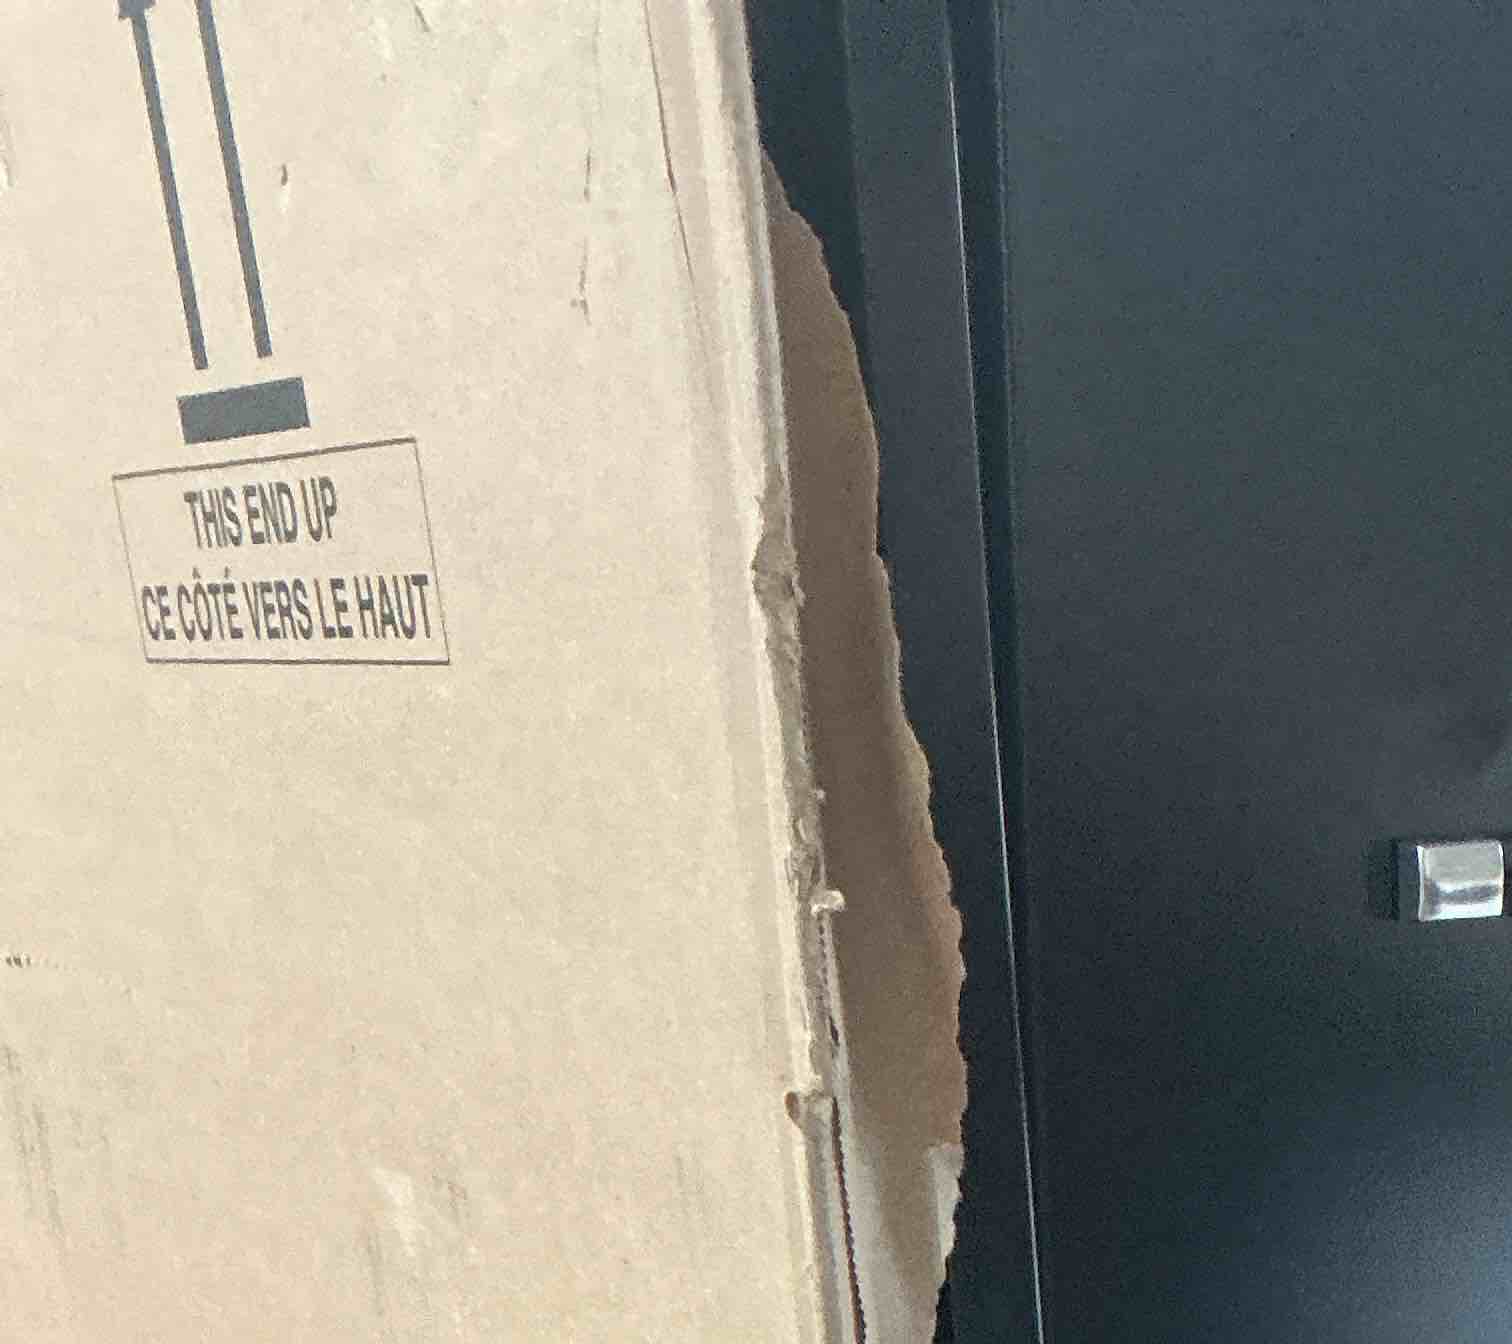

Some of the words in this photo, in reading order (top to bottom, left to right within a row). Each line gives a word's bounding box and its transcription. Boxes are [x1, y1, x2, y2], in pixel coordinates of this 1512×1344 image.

[184, 486, 242, 548] THIS
[243, 481, 297, 545] END
[300, 476, 337, 542] UP
[142, 582, 176, 641] CE
[177, 566, 243, 642] CÔTÉ
[243, 577, 313, 641] VERS
[314, 577, 353, 639] LE
[354, 574, 431, 640] HAUT
